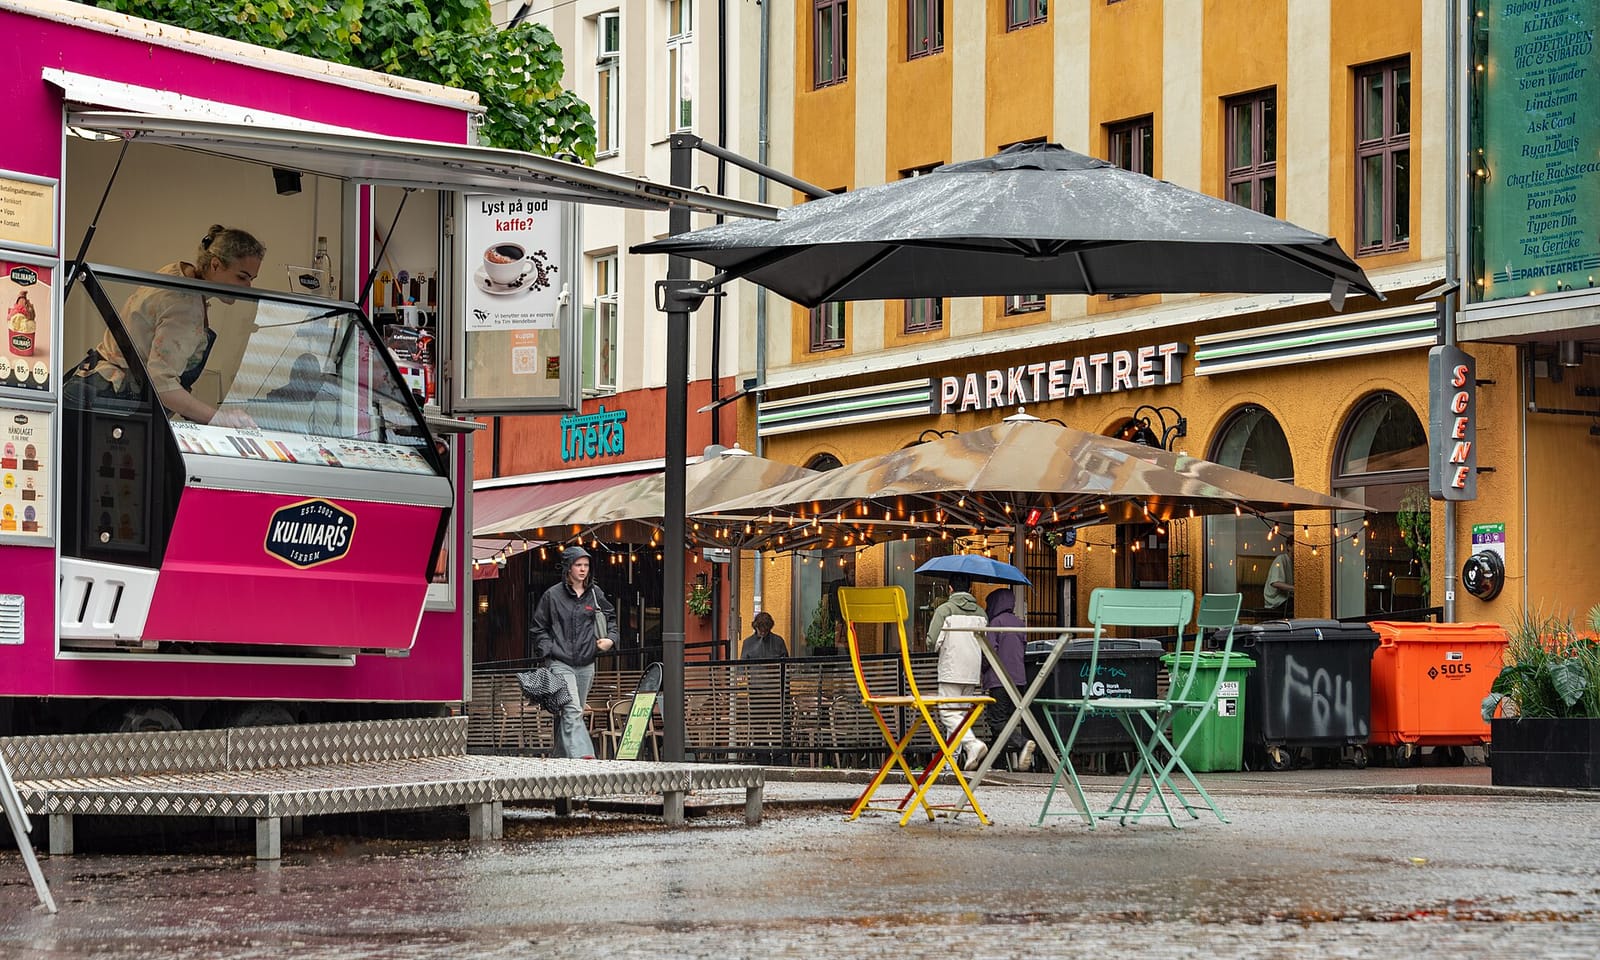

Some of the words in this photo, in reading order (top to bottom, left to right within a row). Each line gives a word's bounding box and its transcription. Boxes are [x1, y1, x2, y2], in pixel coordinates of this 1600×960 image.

[1505, 0, 1540, 16] Bigboy
[1536, 53, 1545, 65] &
[1520, 78, 1545, 90] Sven
[1548, 67, 1587, 85] Wunder
[1527, 120, 1548, 133] Ask
[1551, 112, 1576, 129] Carol
[1521, 144, 1551, 158] Ryan
[1553, 136, 1579, 151] Davis
[1507, 170, 1545, 187] Charlie
[482, 201, 504, 216] Lyst
[509, 199, 523, 215] på
[527, 200, 548, 214] god
[1527, 198, 1551, 210] Pom
[1553, 192, 1577, 206] Poko
[496, 218, 534, 232] kaffe?
[1527, 219, 1559, 234] Typen
[1561, 214, 1577, 227] Din
[1523, 244, 1540, 256] Isa
[1542, 237, 1580, 252] Gericke
[1521, 260, 1584, 279] PARKTEATRET
[941, 342, 1183, 414] PARKTEATRET
[1450, 364, 1471, 489] SCENE
[300, 505, 316, 516] EST.
[272, 516, 349, 552] KULINARIS
[1441, 663, 1472, 675] SOCS
